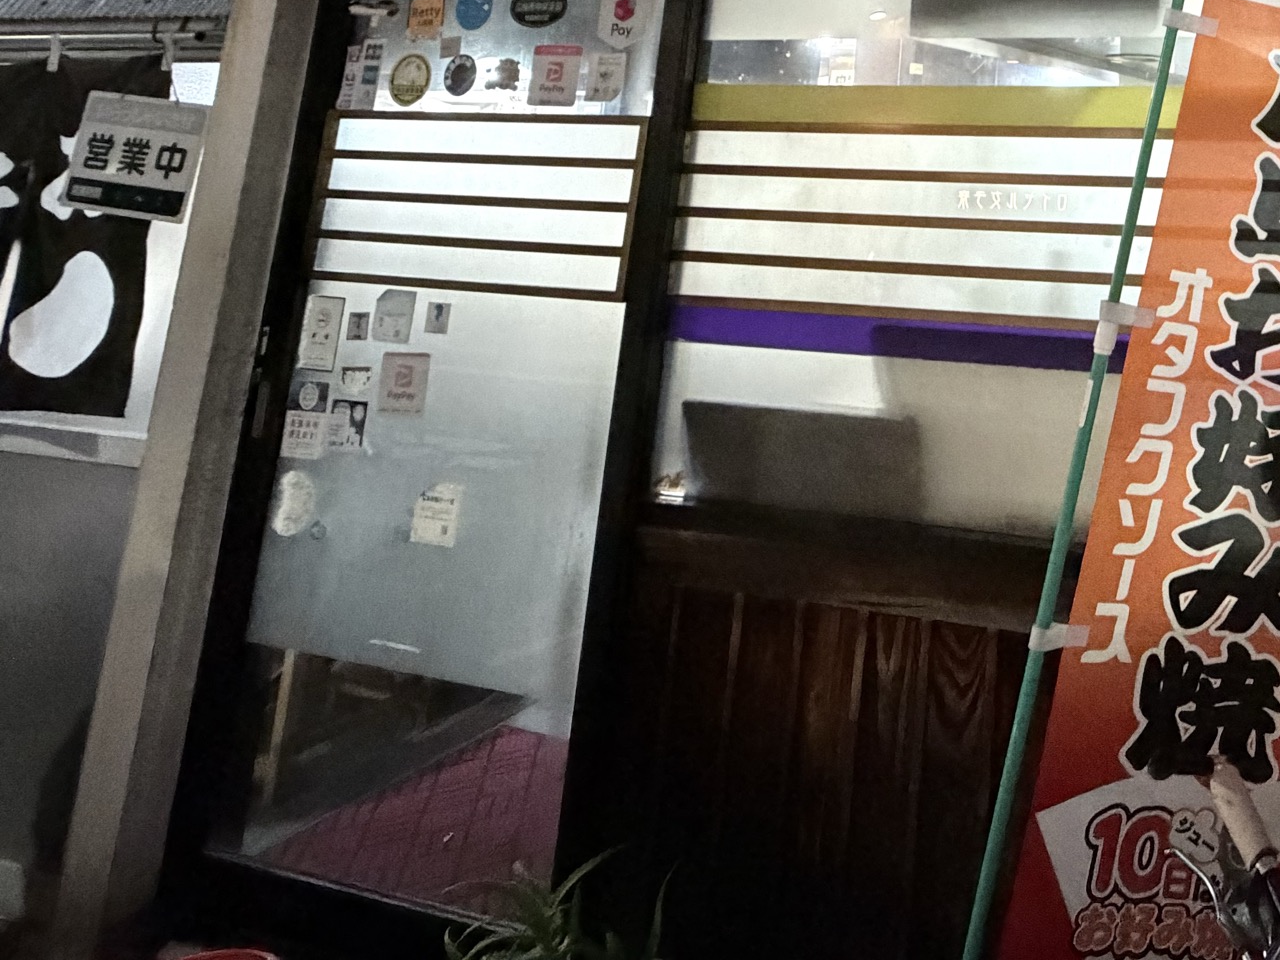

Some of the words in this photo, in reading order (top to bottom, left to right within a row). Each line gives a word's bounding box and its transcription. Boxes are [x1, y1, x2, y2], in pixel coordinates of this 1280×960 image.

[610, 23, 633, 38] Pay
[83, 132, 188, 180] 営業中
[1081, 268, 1215, 665] オタフクソース
